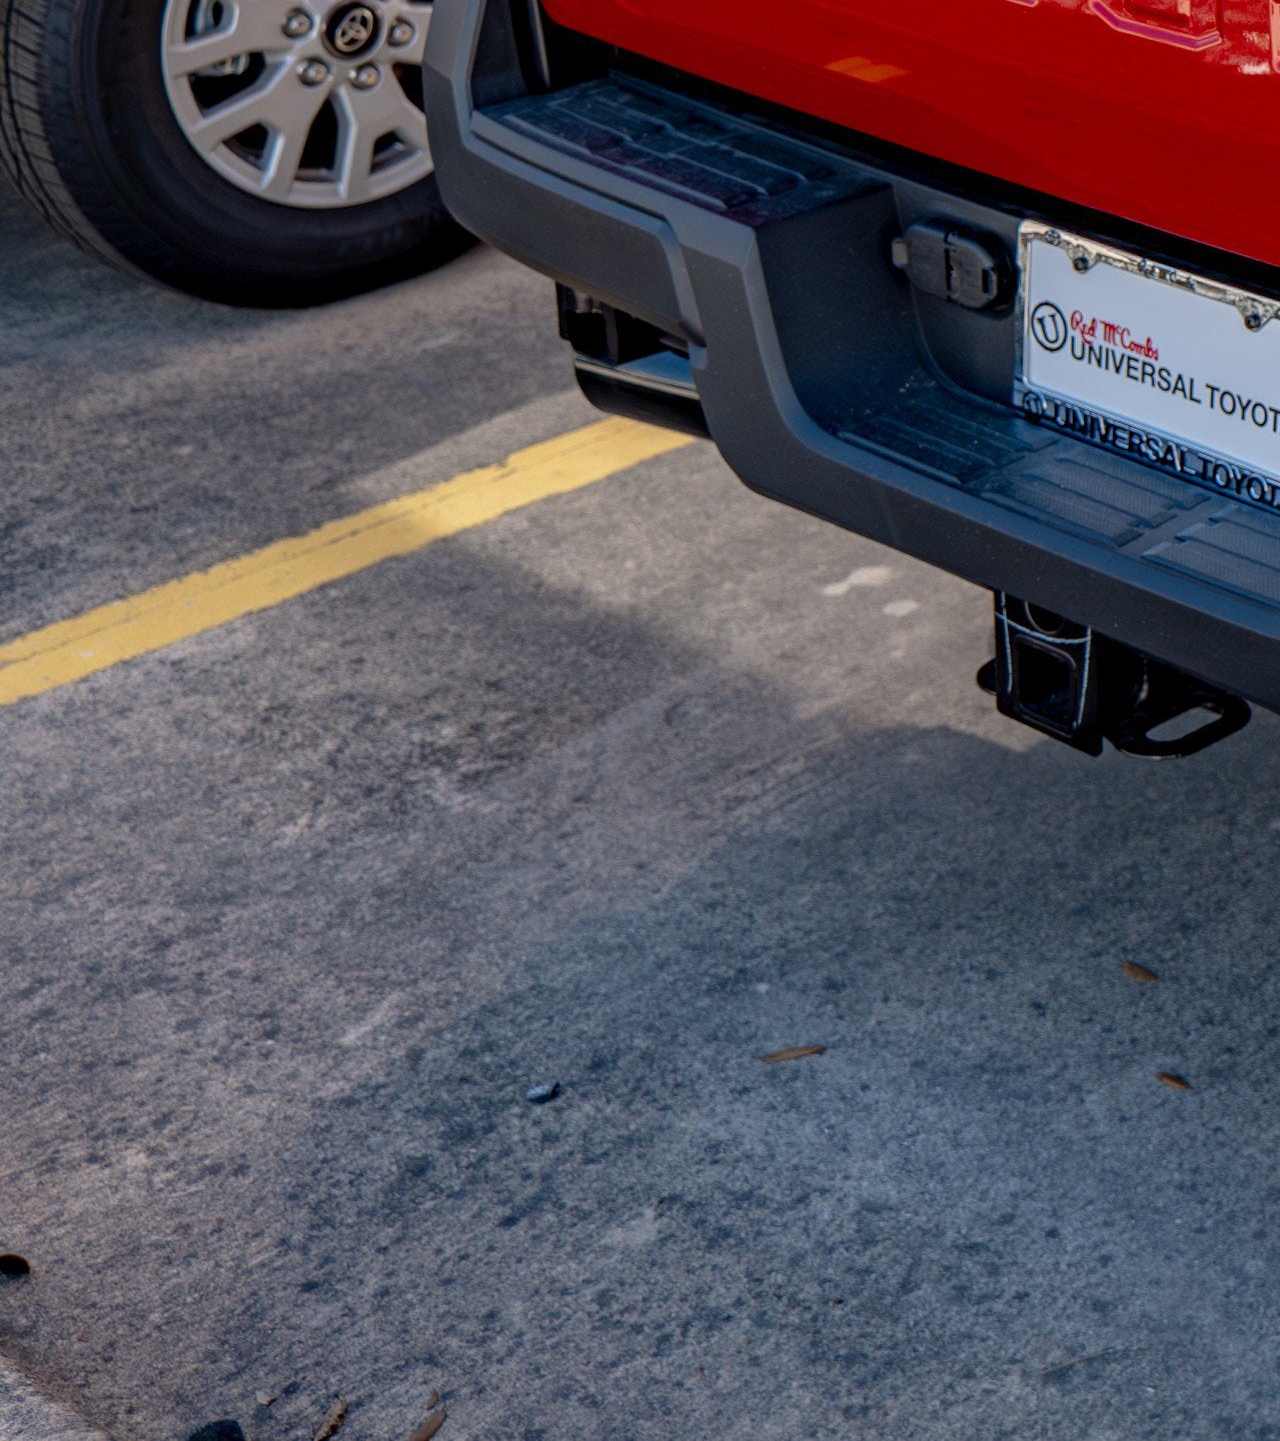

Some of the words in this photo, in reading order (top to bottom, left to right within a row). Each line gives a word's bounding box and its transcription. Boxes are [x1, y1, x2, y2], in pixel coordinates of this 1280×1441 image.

[1069, 309, 1097, 346] Red
[1100, 319, 1160, 362] McCombs
[1070, 335, 1202, 405] UNIVERSAL
[1053, 401, 1198, 477] UNIVERSAL
